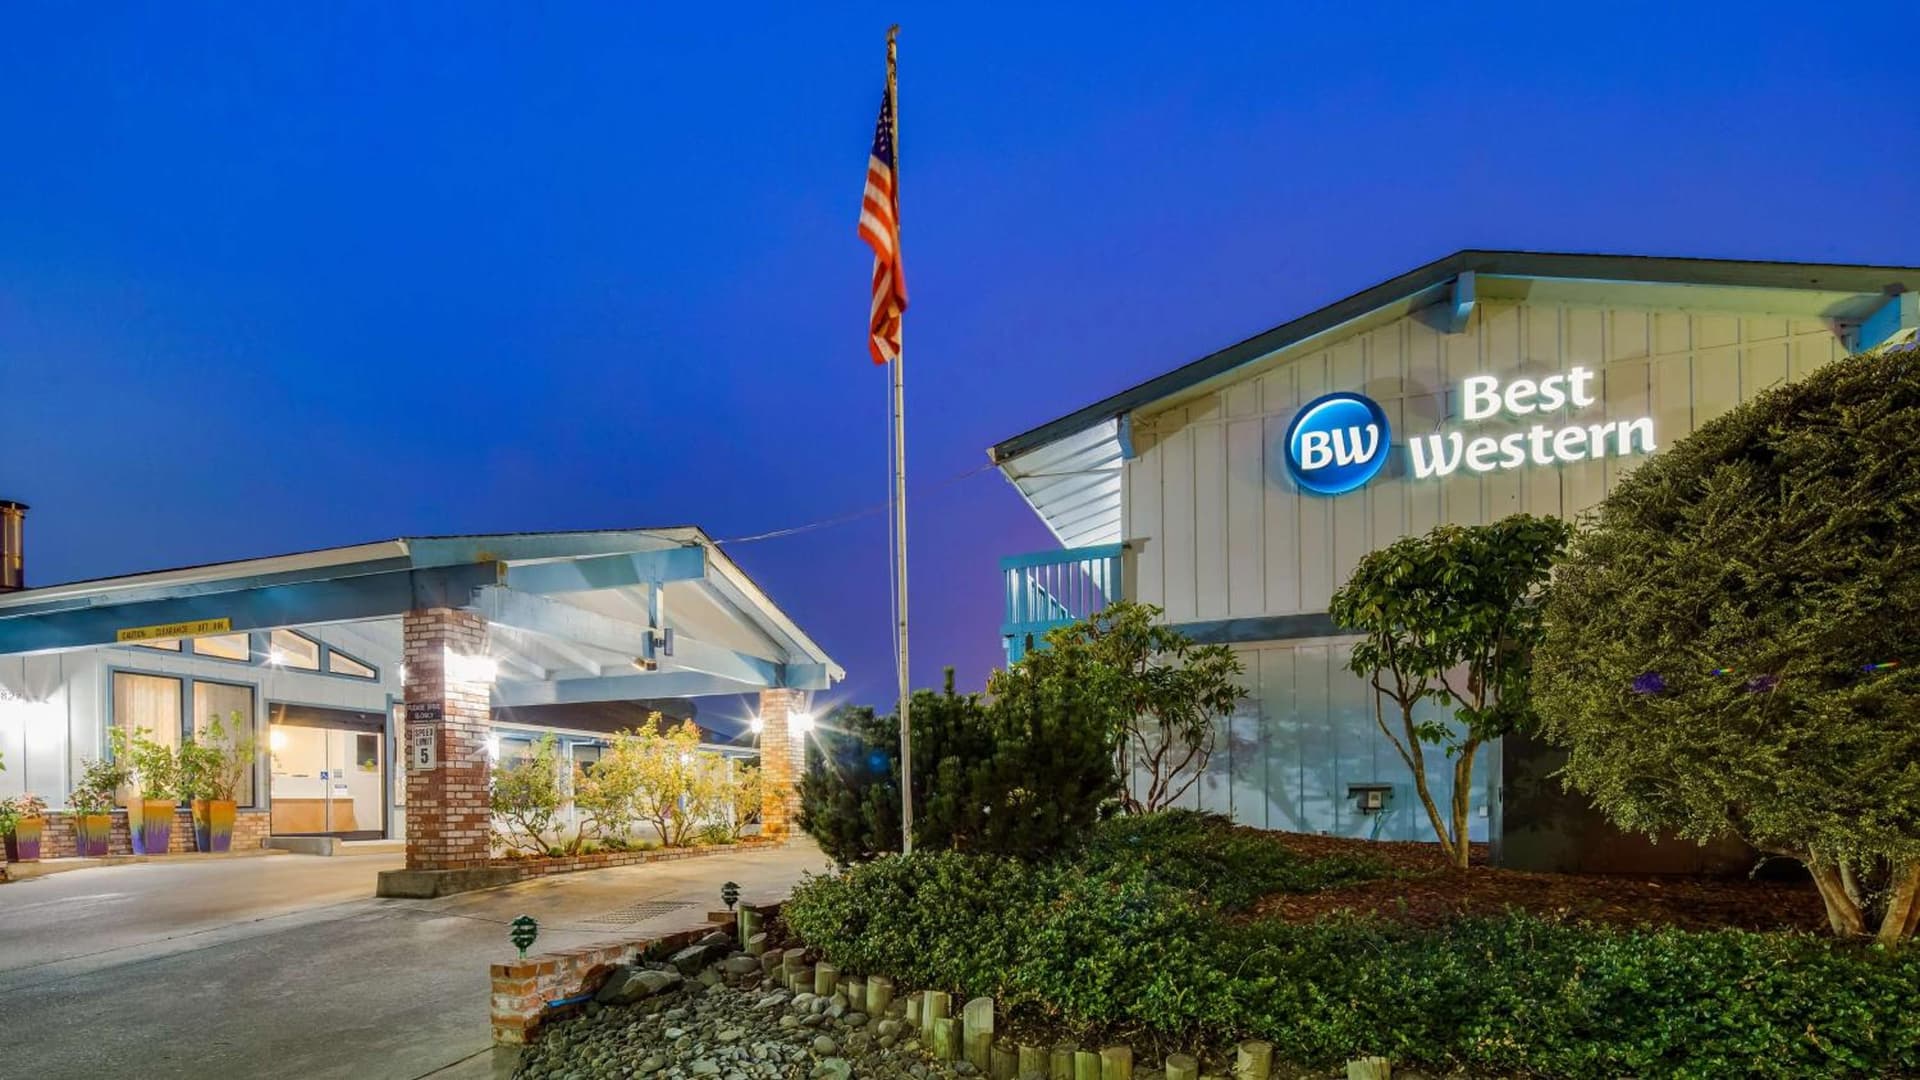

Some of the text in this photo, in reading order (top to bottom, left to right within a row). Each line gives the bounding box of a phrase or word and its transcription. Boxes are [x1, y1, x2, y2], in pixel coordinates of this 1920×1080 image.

[1463, 366, 1595, 420] Best
[1301, 423, 1379, 470] BW
[1408, 416, 1657, 479] Western
[122, 630, 146, 640] CAUTION
[156, 625, 188, 636] CLEARANCE
[415, 728, 433, 736] SPEED
[416, 737, 432, 746] LIMIT
[420, 748, 429, 764] 5
